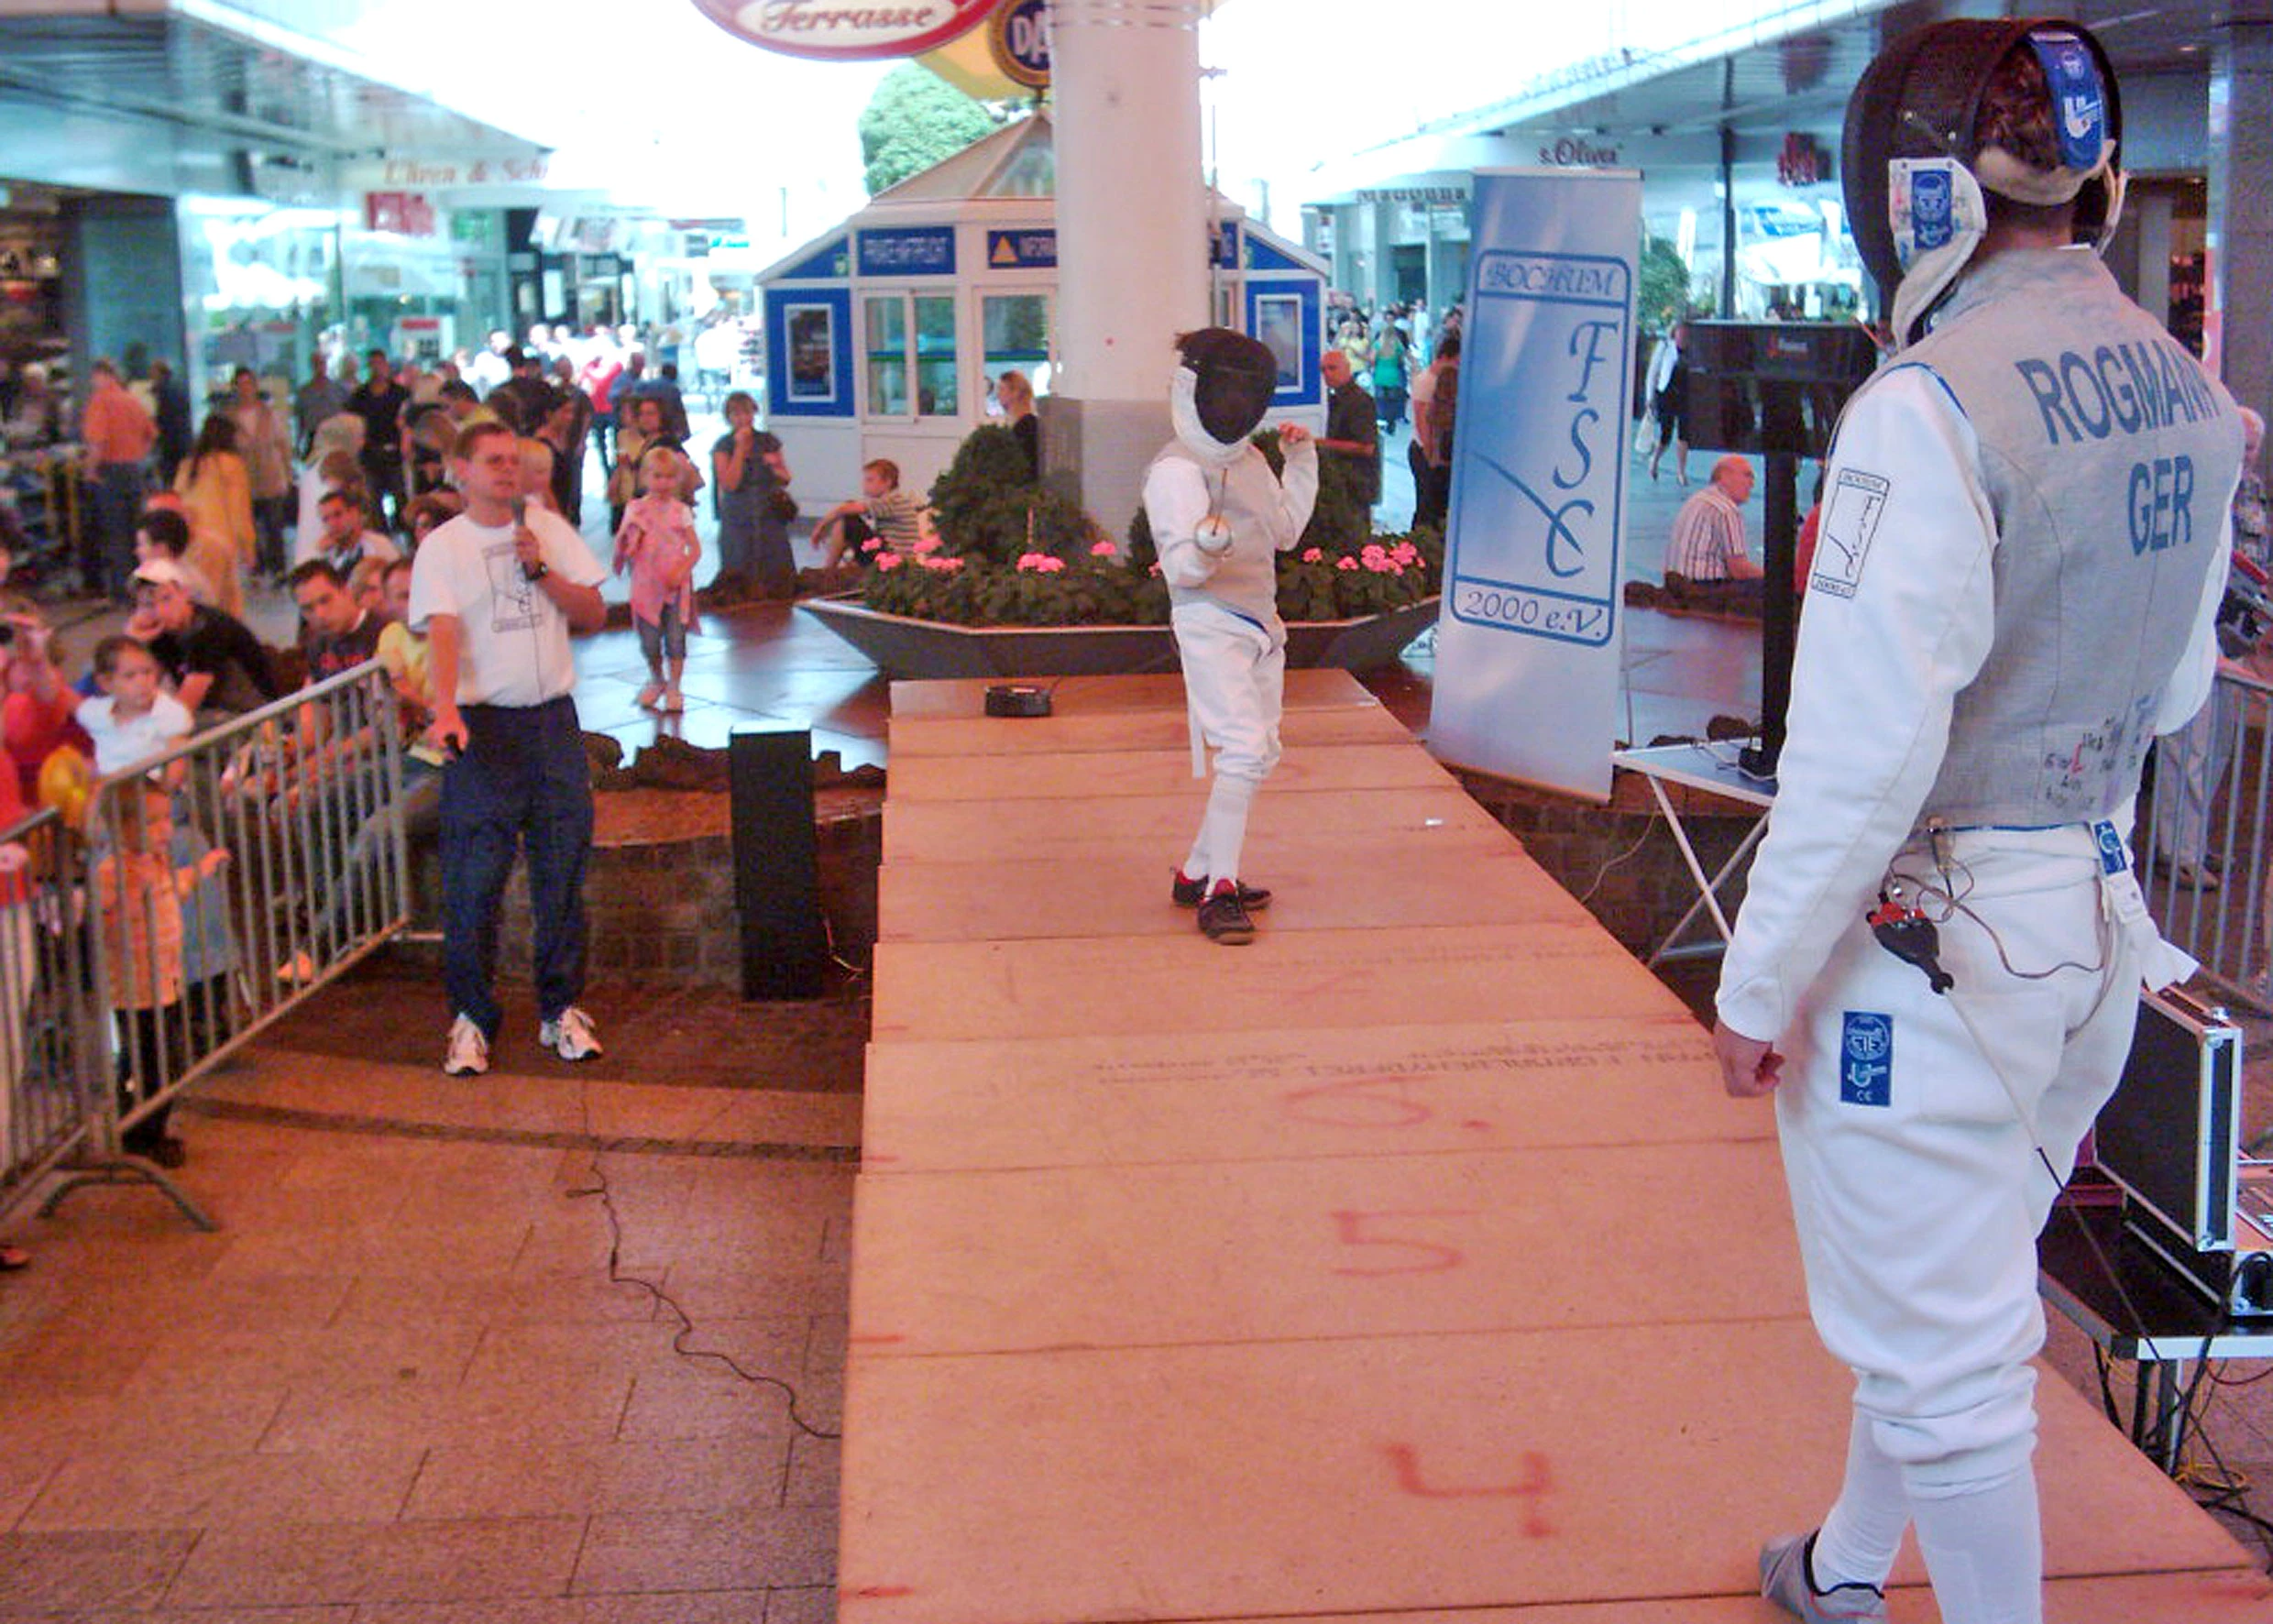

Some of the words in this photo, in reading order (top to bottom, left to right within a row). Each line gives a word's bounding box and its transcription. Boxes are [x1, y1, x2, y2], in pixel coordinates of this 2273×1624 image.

[760, 0, 933, 32] Terrasse
[2127, 455, 2194, 556] GER
[1464, 590, 1540, 625] 2000
[1544, 608, 1604, 638] e.V.
[1328, 1209, 1480, 1278] 5
[1379, 1441, 1555, 1540] 4
